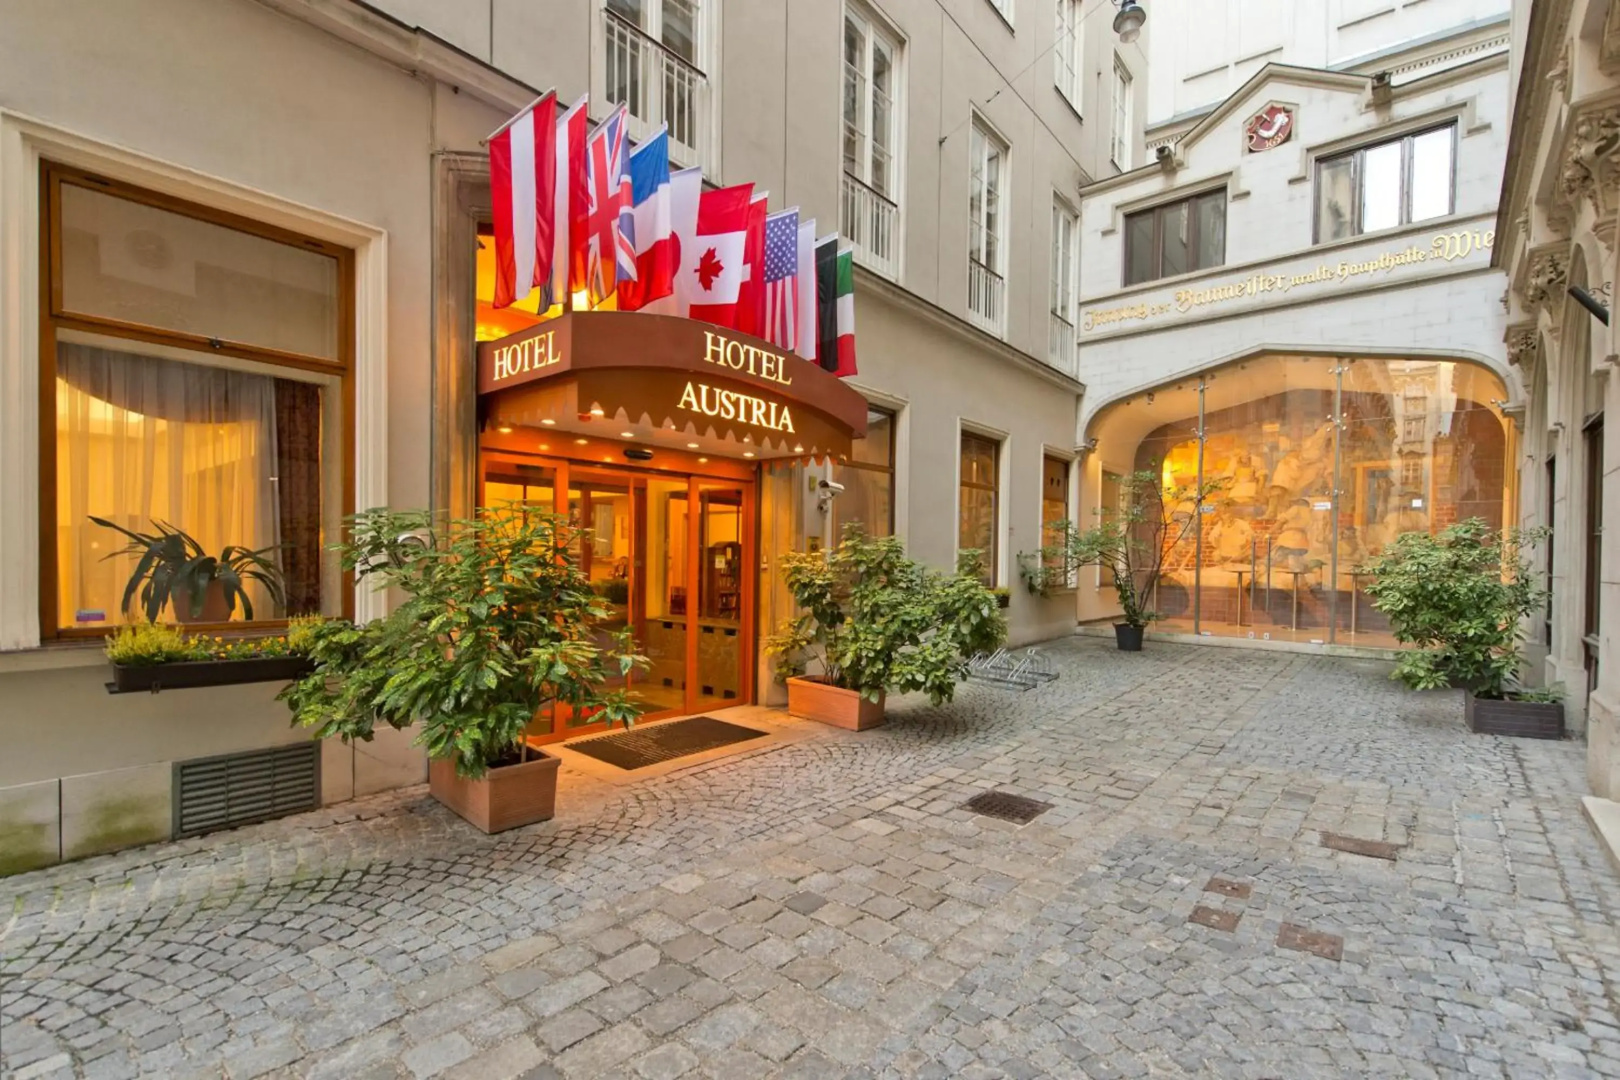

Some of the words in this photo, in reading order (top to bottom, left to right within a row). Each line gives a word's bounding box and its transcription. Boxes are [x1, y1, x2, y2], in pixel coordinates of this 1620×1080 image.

[493, 330, 562, 381] HOTEL
[703, 331, 792, 386] HOTEL
[677, 381, 796, 434] AUSTRIA
